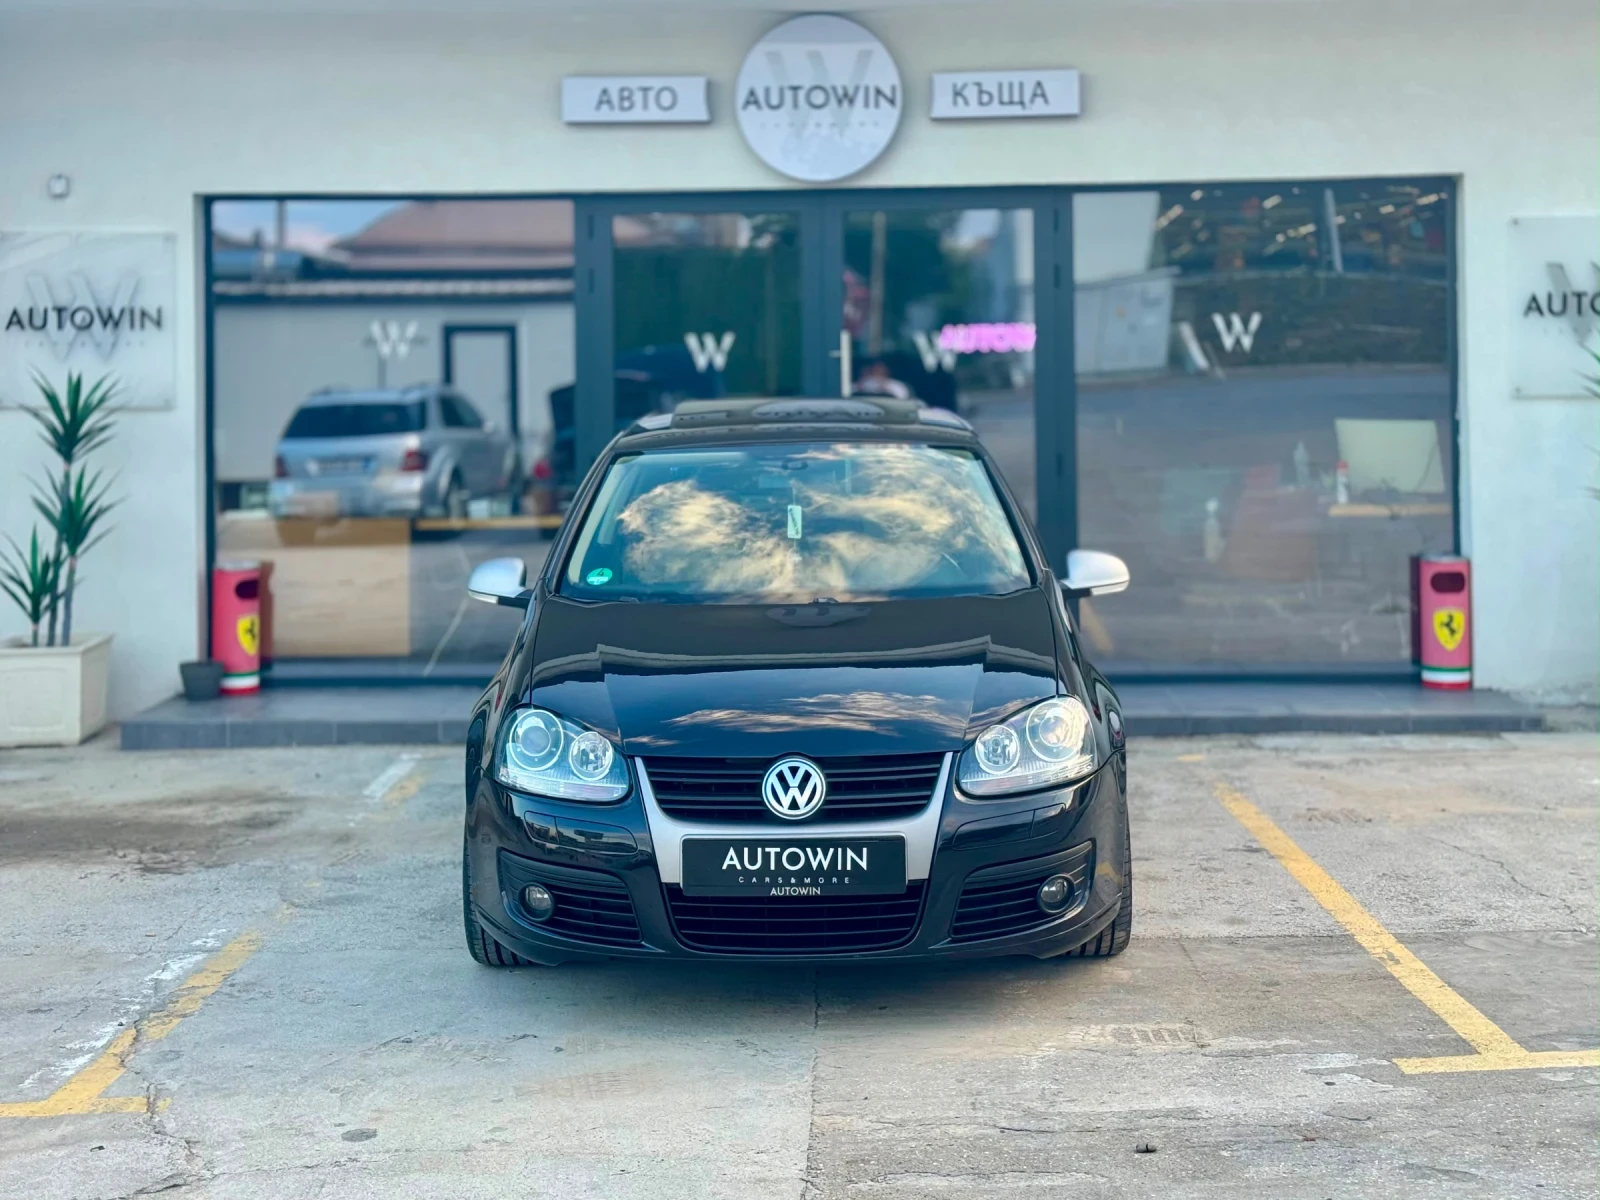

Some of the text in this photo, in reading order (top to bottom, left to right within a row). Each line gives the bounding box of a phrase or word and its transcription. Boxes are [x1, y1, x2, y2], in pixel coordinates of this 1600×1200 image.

[594, 86, 679, 113] АВТО
[741, 83, 898, 111] AUTOWIN
[951, 80, 1050, 111] КЪЩА
[5, 304, 163, 332] AUTOWIN
[1212, 311, 1262, 353] W
[369, 320, 420, 359] W
[684, 331, 736, 373] W
[766, 761, 823, 816] VW
[721, 846, 868, 871] AUTOWIN
[770, 886, 821, 896] AUTOWIN
